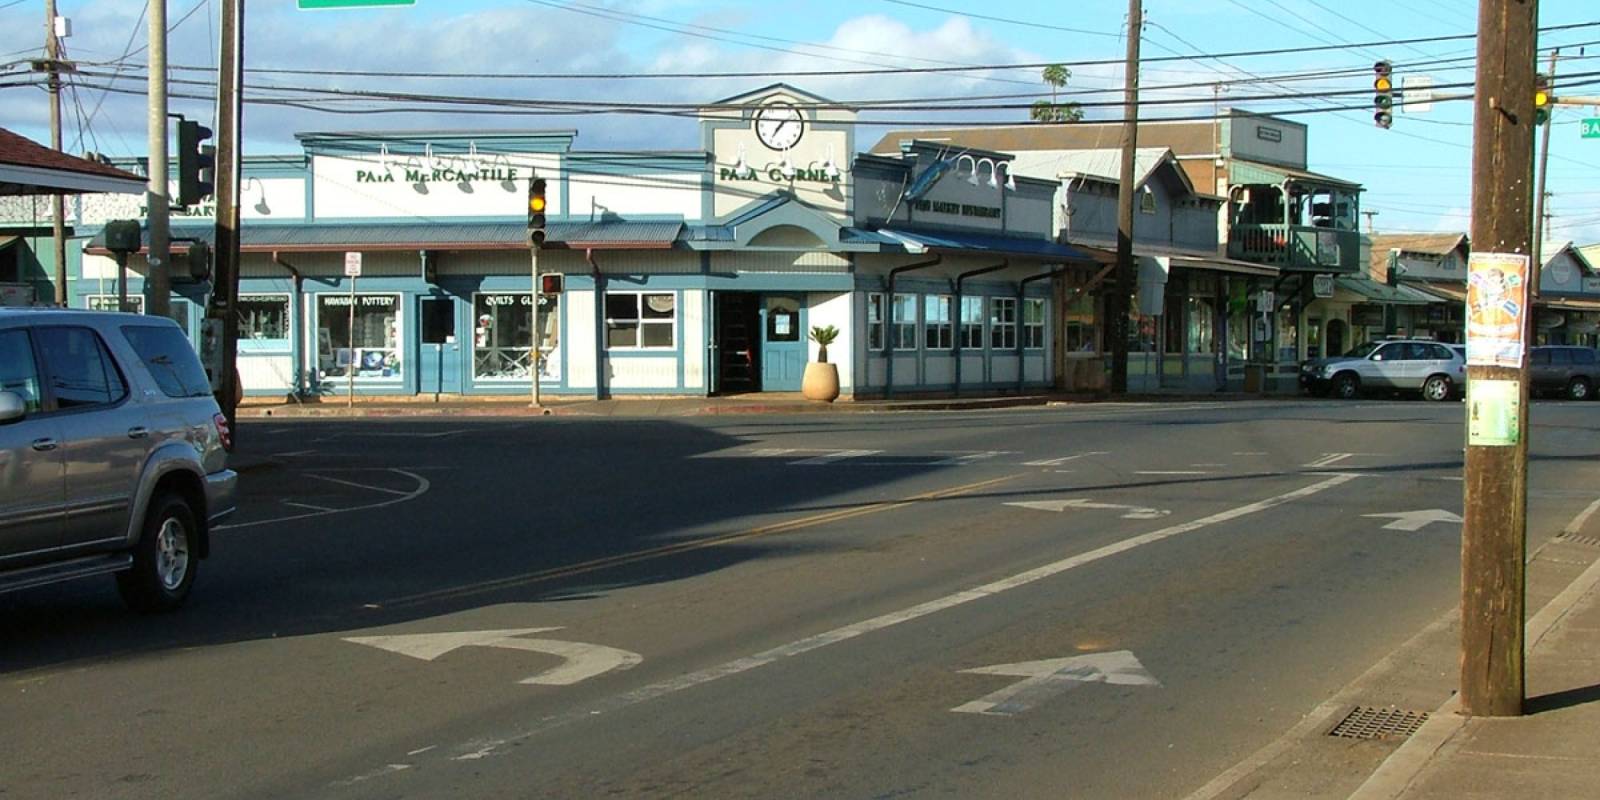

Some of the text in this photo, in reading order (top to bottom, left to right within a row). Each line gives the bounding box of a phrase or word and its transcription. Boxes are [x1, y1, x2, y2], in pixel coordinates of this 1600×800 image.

[405, 168, 518, 182] MERCANTILE
[362, 296, 394, 306] POTTERY
[485, 295, 548, 306] QUILTS GLSS
